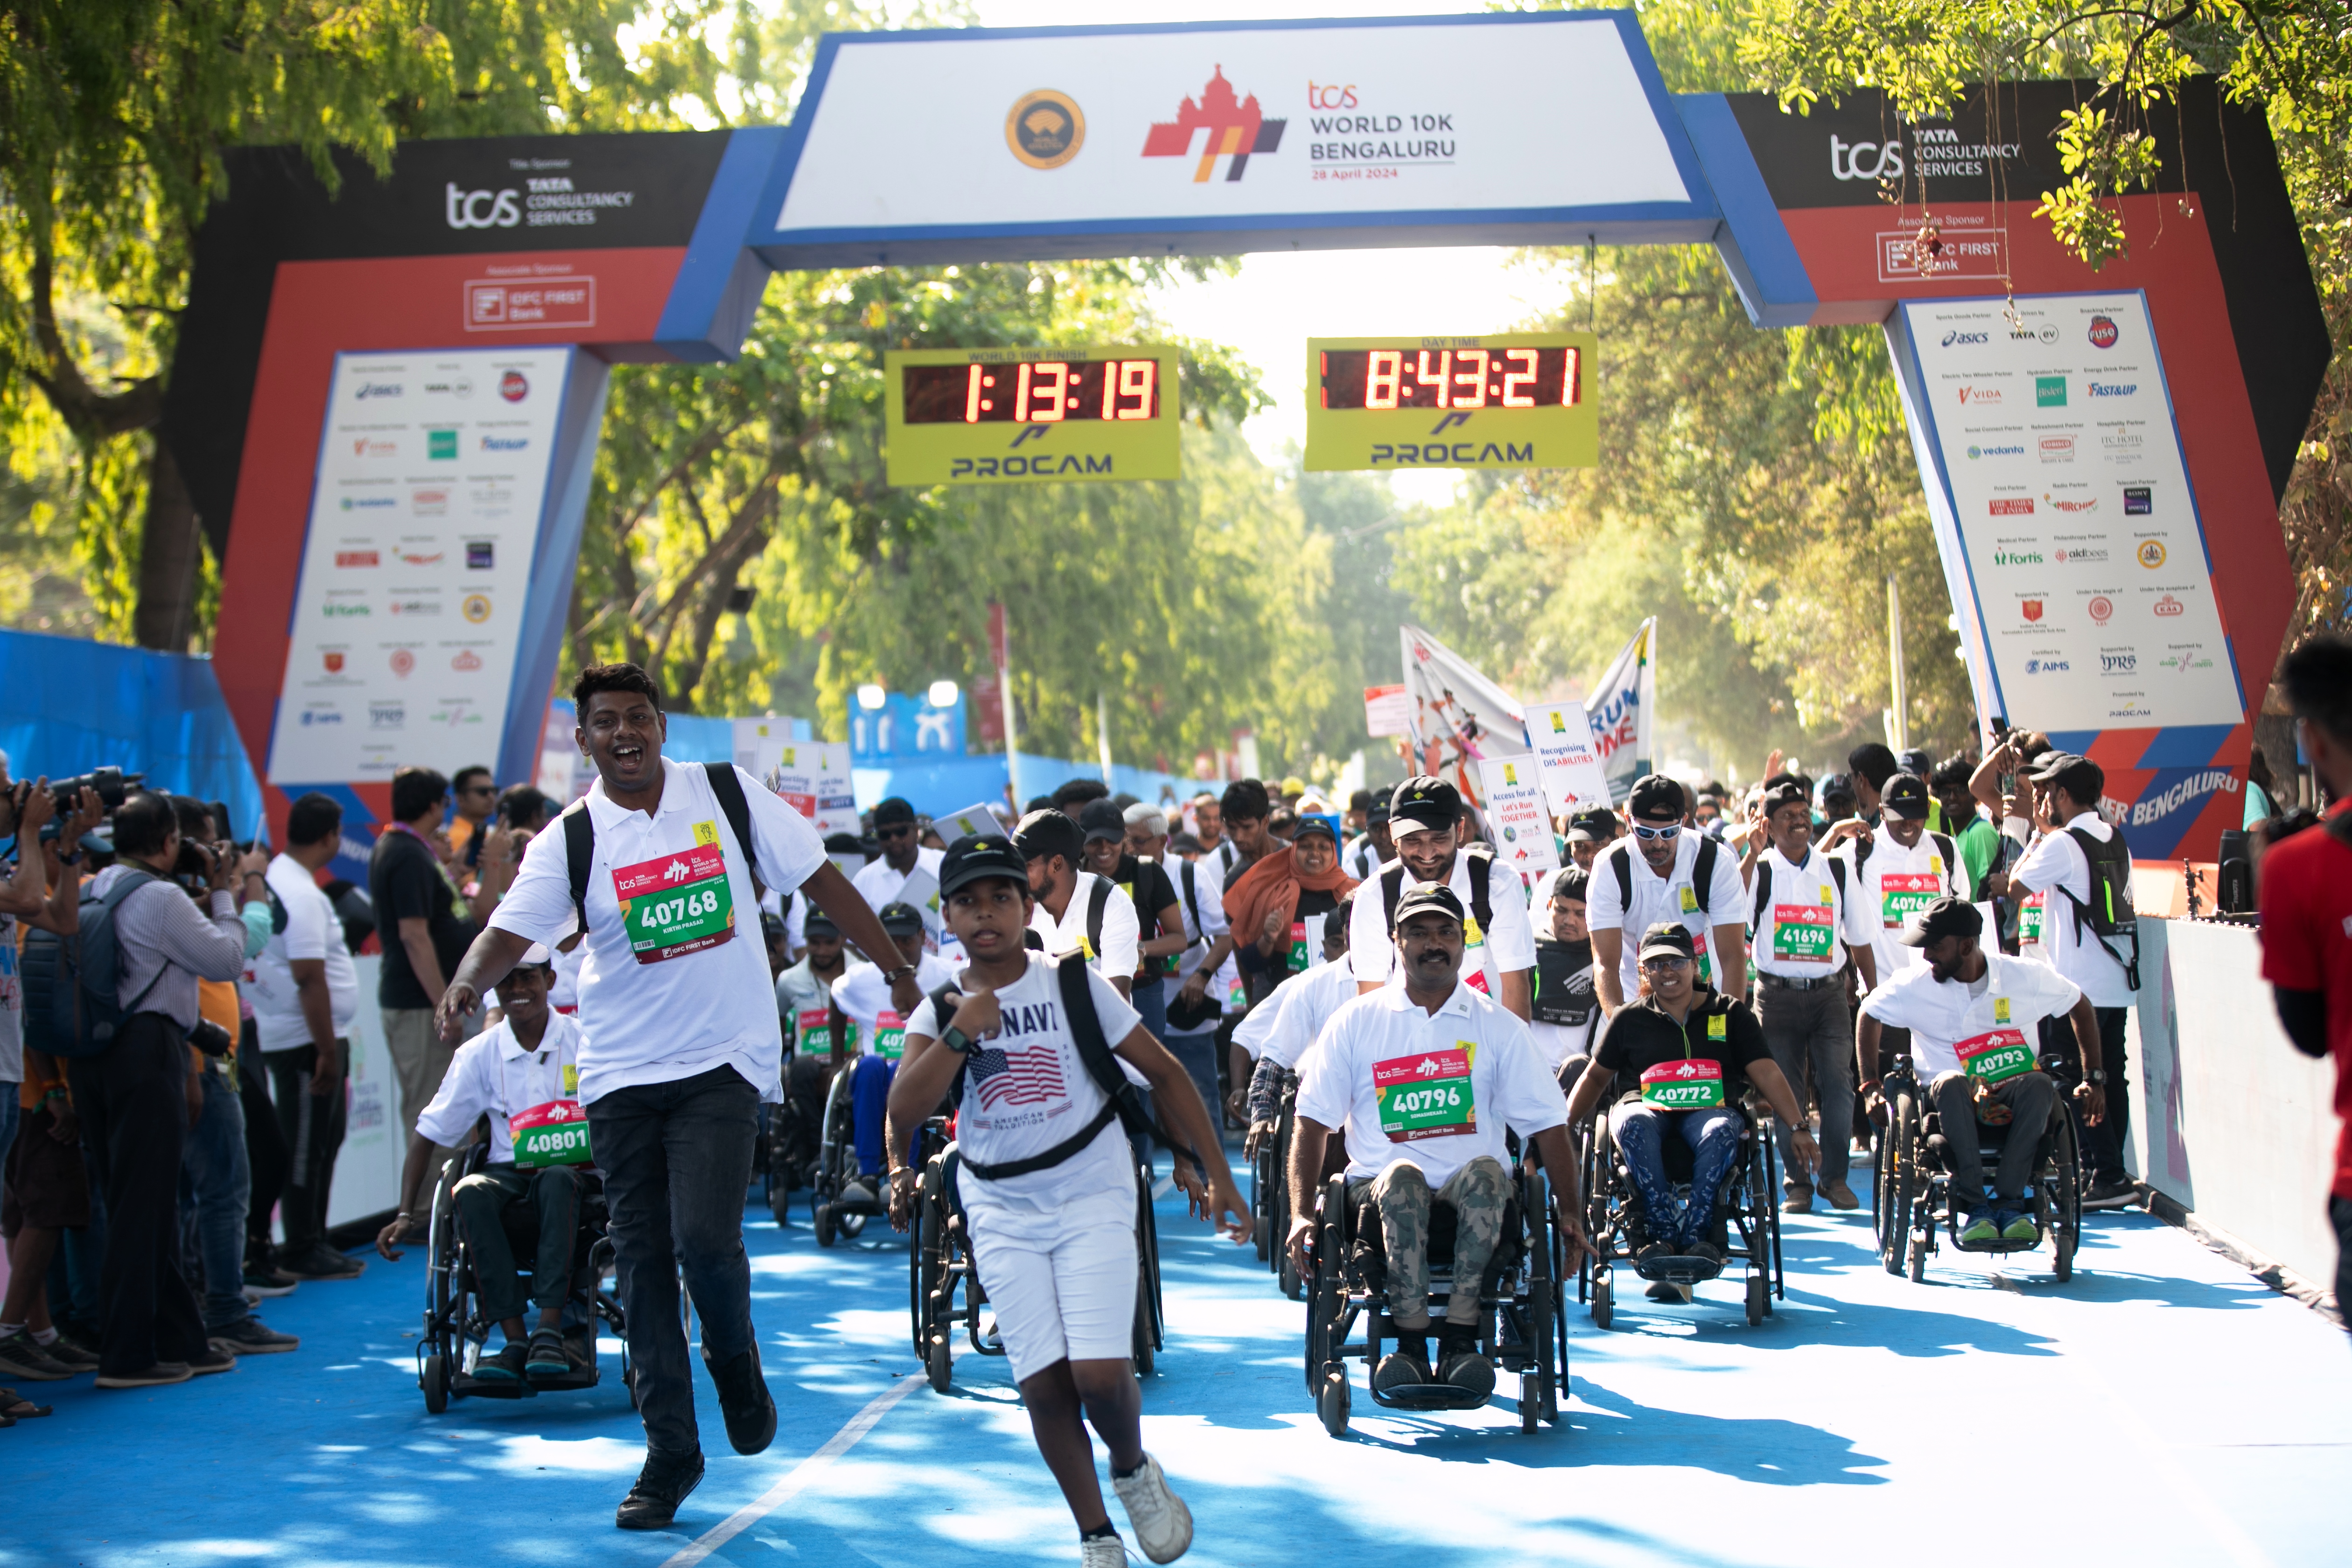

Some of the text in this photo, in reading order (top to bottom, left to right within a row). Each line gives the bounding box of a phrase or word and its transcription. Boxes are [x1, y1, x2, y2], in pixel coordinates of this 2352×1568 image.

[1309, 79, 1358, 110] tcs
[1311, 113, 1454, 134] WORLD 10K
[1912, 128, 1959, 143] TATA
[1311, 140, 1456, 160] BENGALURU
[1830, 134, 1904, 180] tcs
[1913, 144, 2021, 160] CONSULTANCY
[532, 159, 570, 170] Sponsor
[1913, 161, 1983, 177] SERVICES
[1312, 168, 1398, 180] 28 April 2024
[526, 177, 573, 193] TATA
[446, 182, 520, 229] tcs
[526, 192, 634, 209] CONSULTANCY
[526, 209, 596, 226] SERVICES
[1946, 215, 1985, 227] Sponsor
[1959, 242, 1999, 256] FIRST
[545, 289, 585, 304] FIRST
[509, 307, 544, 321] Bank
[2009, 330, 2055, 340] TATA ev
[1421, 337, 1480, 348] DAY TIME
[968, 350, 1087, 362] WORLD 10K FINISH
[1365, 348, 1577, 410] 8:43:21
[966, 359, 1155, 424] 1:13:19
[1973, 389, 2002, 399] VIDA
[1371, 442, 1533, 464] PROCAM
[1983, 445, 2024, 456] vedanta
[950, 454, 1113, 478] PROCAM
[2009, 551, 2044, 565] Fortis
[2042, 661, 2070, 672] AIMS
[1540, 743, 1586, 756] Recognising
[1543, 754, 1593, 767] DISABILITIES
[1493, 787, 1537, 801] Access for all.
[2132, 771, 2239, 826] BENGALURU
[1502, 801, 1533, 812] Let's Run
[1499, 811, 1540, 823] TOGETHER.
[693, 862, 720, 873] BENGALURU
[619, 879, 636, 890] tcs
[636, 875, 658, 883] CONSULTANCY
[641, 890, 718, 928] 40768
[1890, 897, 1927, 911] 4076
[663, 918, 704, 934] KIRTHI PRASAD
[1783, 928, 1826, 944] 41696
[686, 942, 701, 951] FIRST
[1976, 1050, 2026, 1074] 40793
[1393, 1087, 1461, 1113] 40796
[1654, 1086, 1712, 1101] 40772
[994, 1112, 1043, 1125] AMERICAN
[1410, 1110, 1443, 1119] SOMASHEKAR
[994, 1118, 1045, 1131] TRADITION
[526, 1129, 586, 1153] 40801
